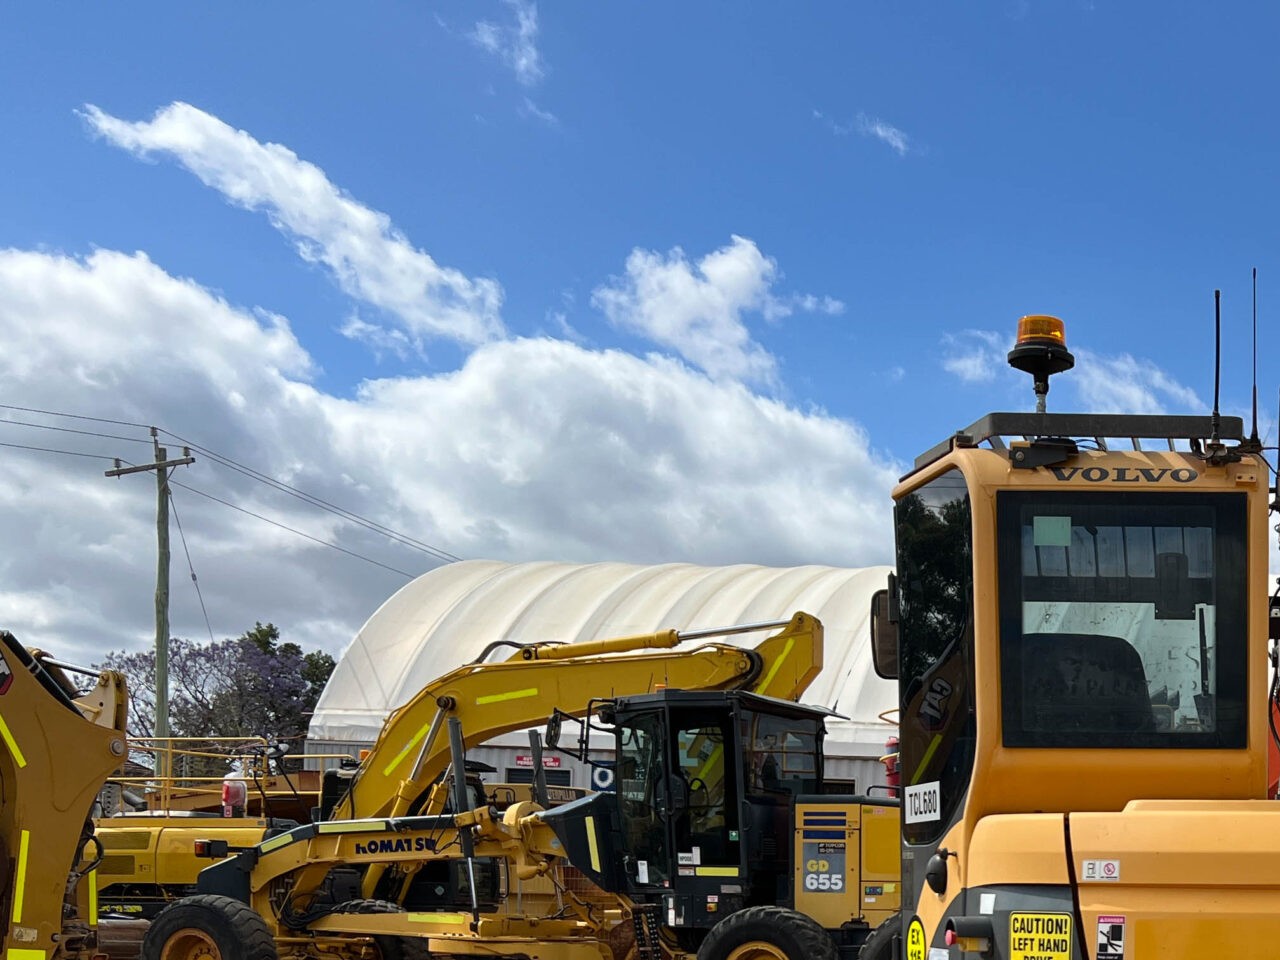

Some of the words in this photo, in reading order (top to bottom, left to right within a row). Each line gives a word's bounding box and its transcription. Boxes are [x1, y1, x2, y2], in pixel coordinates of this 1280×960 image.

[1051, 467, 1198, 482] VOLVO
[909, 789, 937, 816] TCL680
[806, 859, 830, 872] GD
[805, 873, 843, 890] 655
[1012, 917, 1068, 935] CAUTION!
[911, 928, 921, 945] EX
[1013, 937, 1036, 952] LEFT
[1038, 938, 1068, 953] HAND
